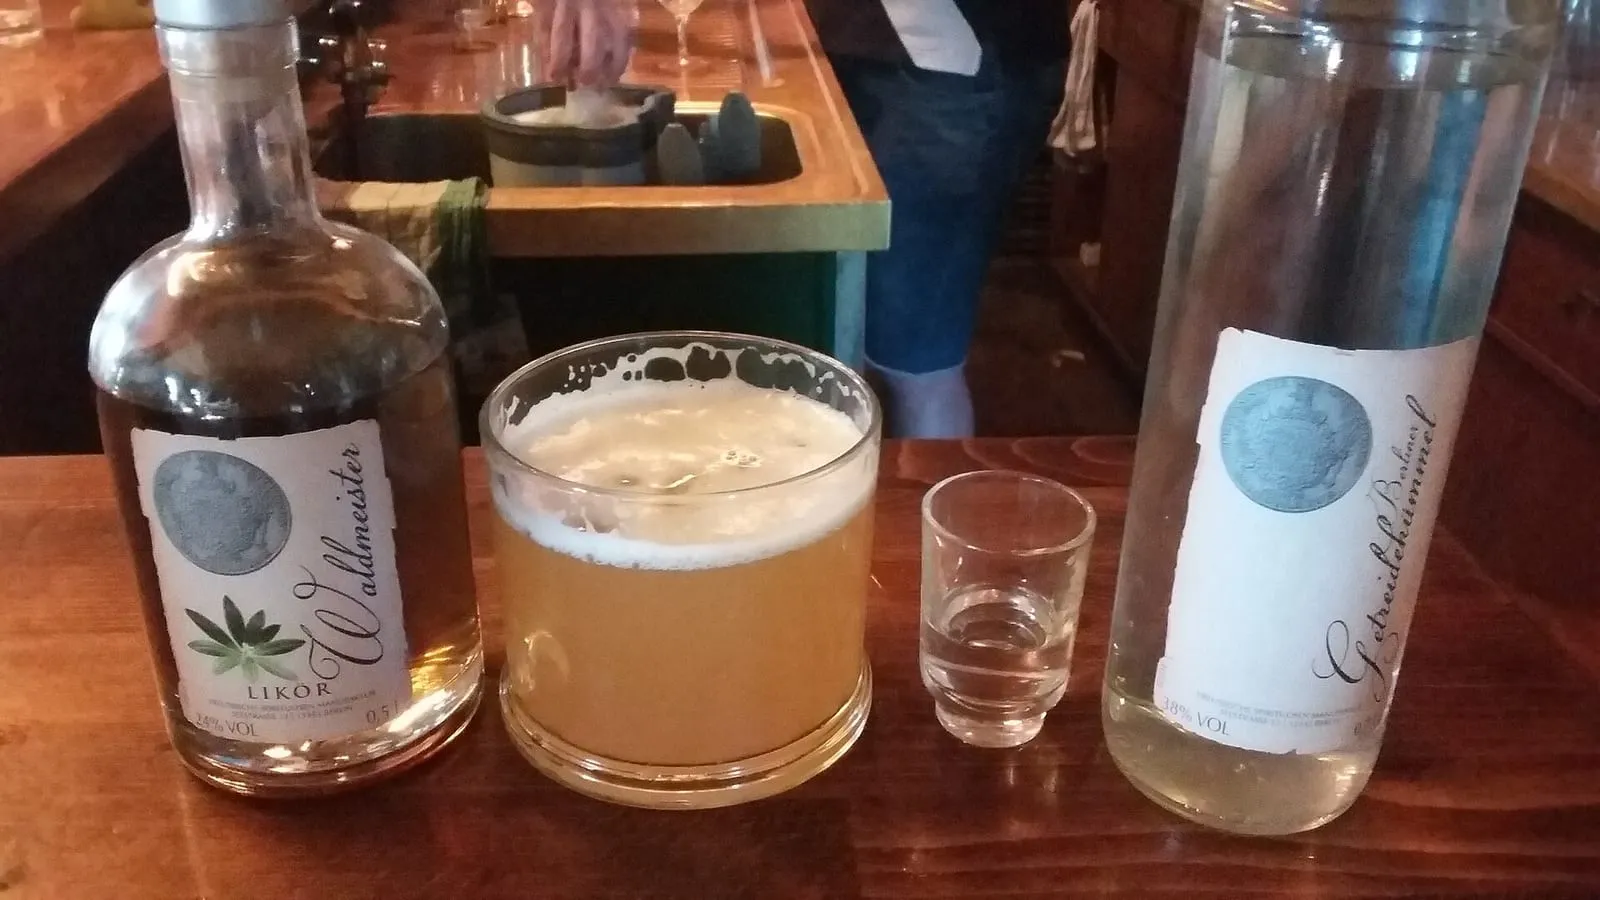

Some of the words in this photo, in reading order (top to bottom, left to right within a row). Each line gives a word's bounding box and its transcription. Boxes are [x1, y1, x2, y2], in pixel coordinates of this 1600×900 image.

[292, 442, 384, 680] Waldmeister
[247, 682, 333, 700] LIKÖR
[225, 719, 260, 737] VOL
[1197, 711, 1231, 736] VOL
